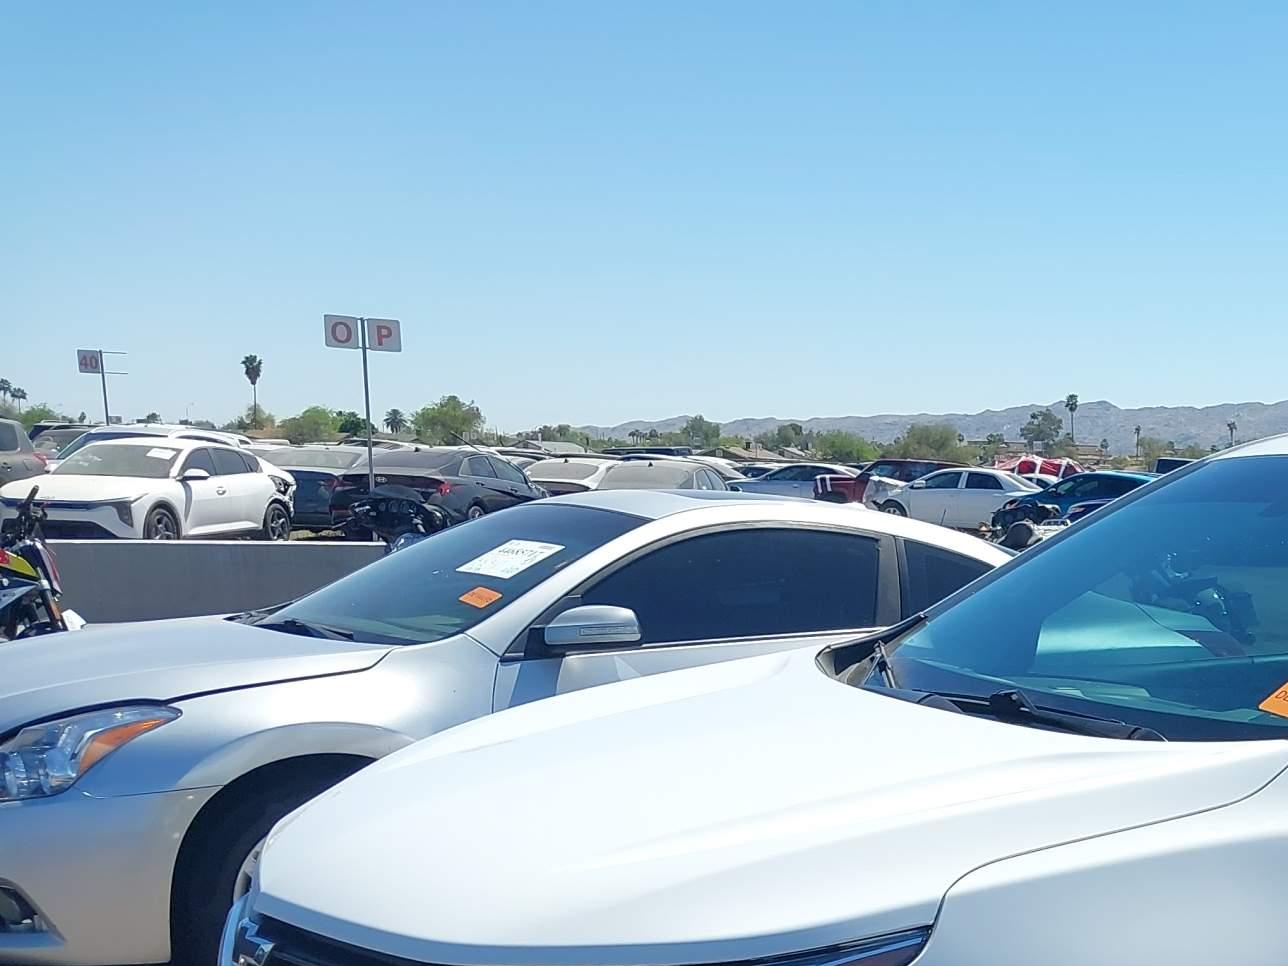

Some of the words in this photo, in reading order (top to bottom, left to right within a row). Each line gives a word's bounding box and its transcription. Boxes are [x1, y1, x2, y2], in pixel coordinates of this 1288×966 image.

[331, 321, 352, 344] O
[376, 325, 393, 347] P
[80, 355, 98, 370] 40
